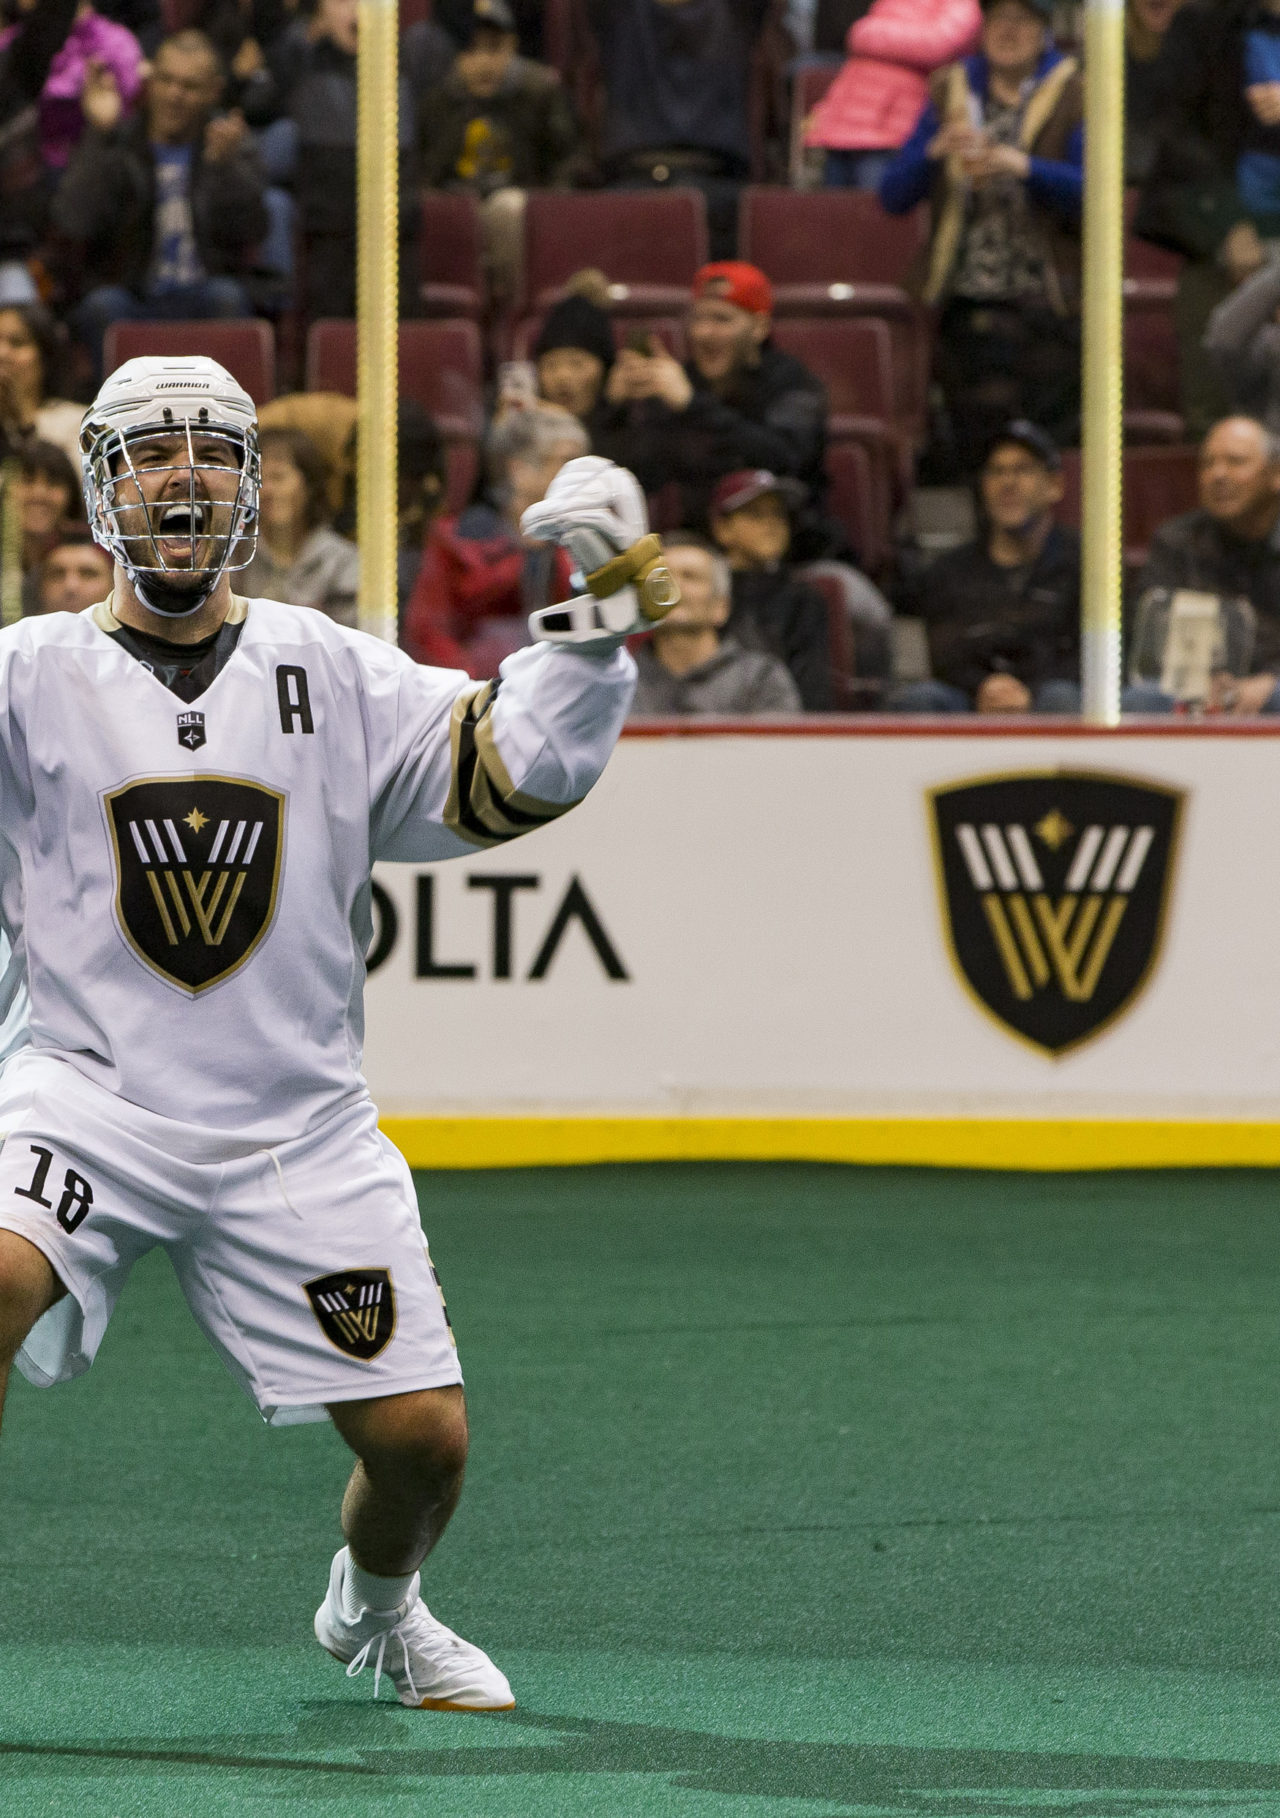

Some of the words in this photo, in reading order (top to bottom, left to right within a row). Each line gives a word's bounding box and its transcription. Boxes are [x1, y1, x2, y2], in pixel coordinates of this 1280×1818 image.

[177, 712, 204, 725] NLL
[275, 663, 315, 735] A
[13, 1143, 94, 1236] 18
